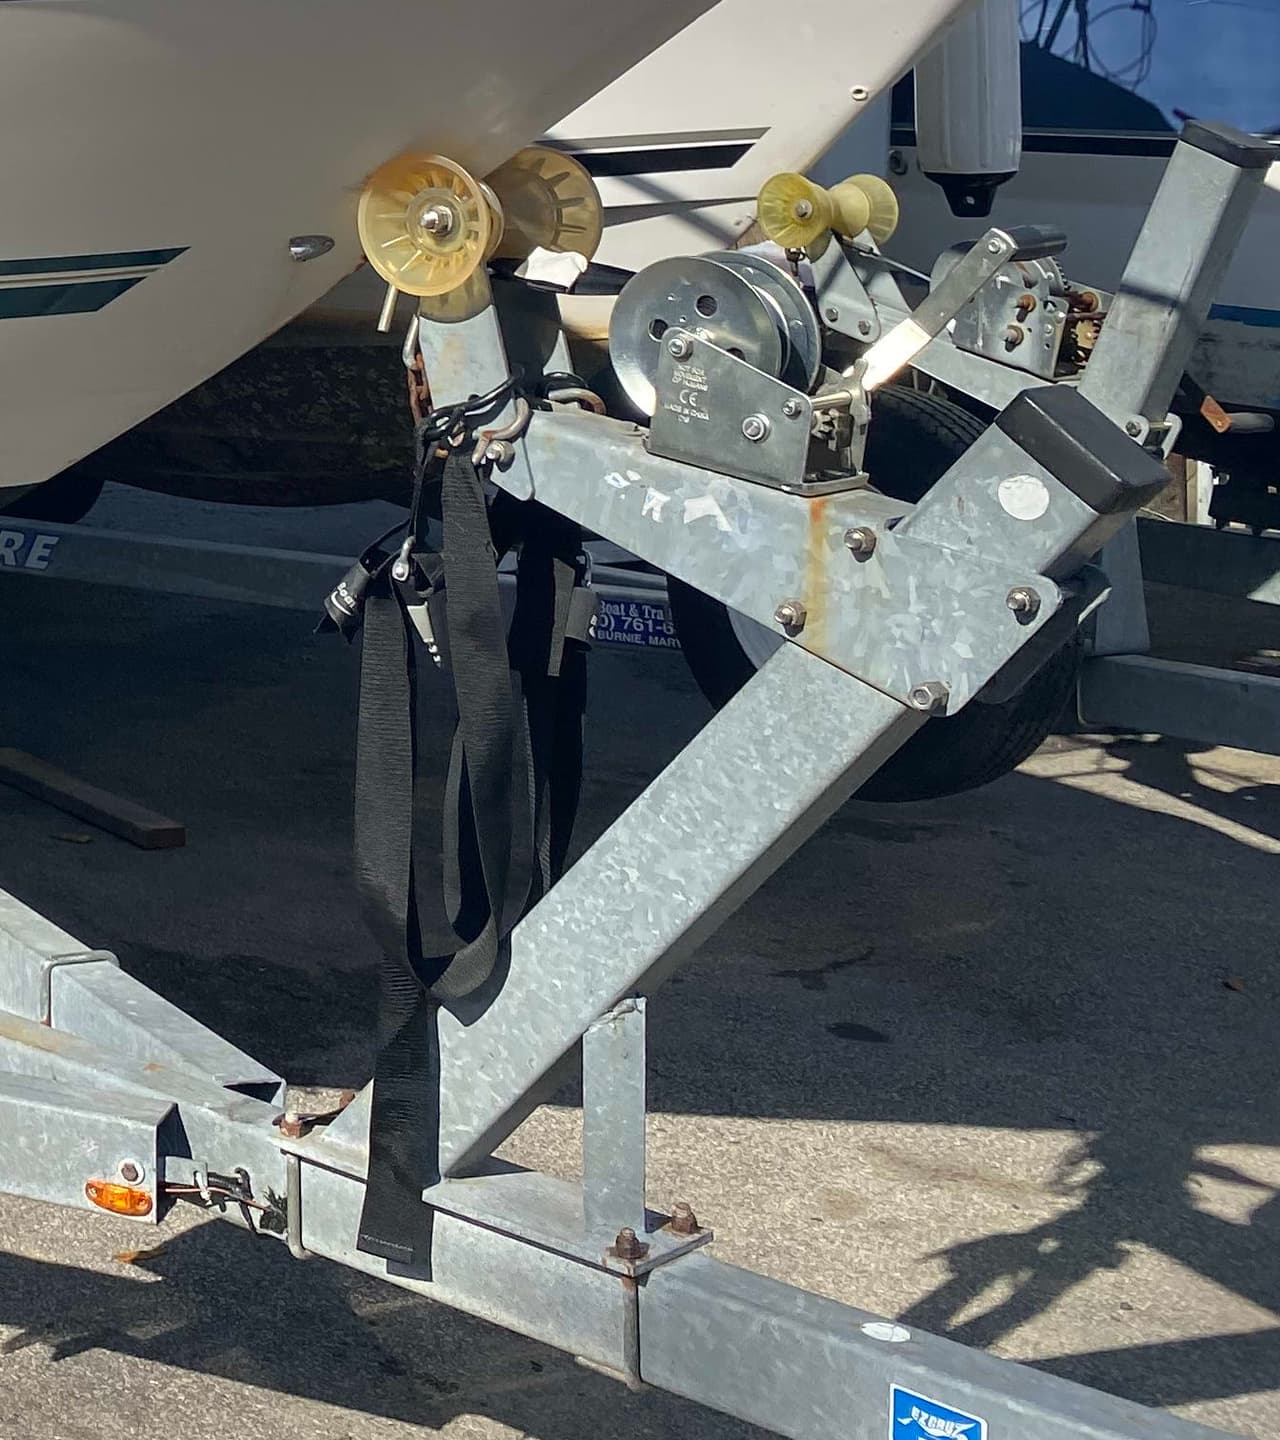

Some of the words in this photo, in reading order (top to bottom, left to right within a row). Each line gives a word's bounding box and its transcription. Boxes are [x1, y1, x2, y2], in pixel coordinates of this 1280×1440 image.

[679, 389, 698, 407] CE
[628, 603, 640, 617] &
[621, 616, 674, 635] 761-6
